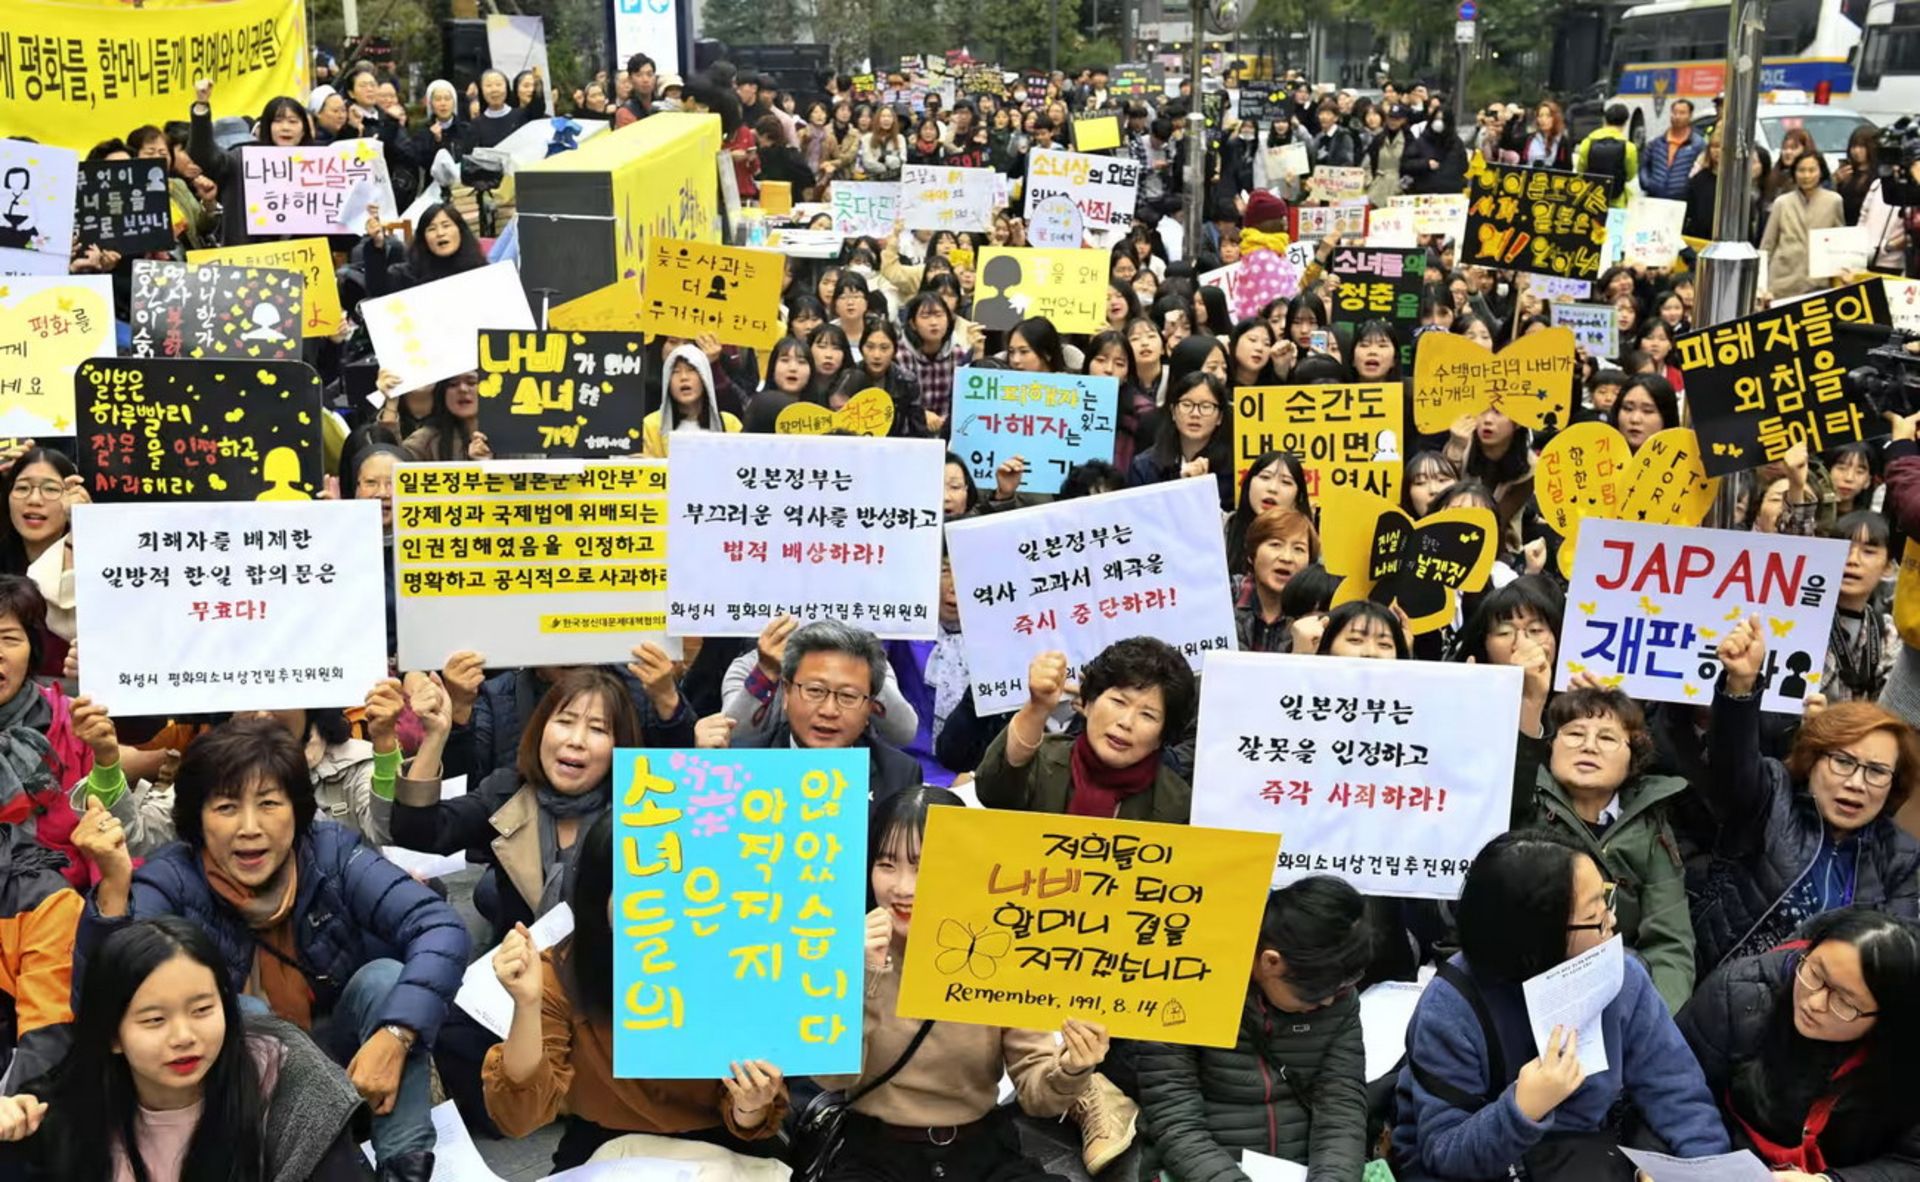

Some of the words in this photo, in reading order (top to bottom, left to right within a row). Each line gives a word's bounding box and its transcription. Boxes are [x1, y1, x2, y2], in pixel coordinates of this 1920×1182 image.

[18, 34, 97, 111] 평화를,
[97, 35, 186, 99] 할머니들께
[191, 29, 234, 87] 명예와
[236, 19, 277, 76] 인권을
[245, 157, 293, 184] 나비
[299, 157, 371, 189] 진실을
[1033, 154, 1104, 186] 소녀상의
[1106, 163, 1138, 188] 외침
[75, 188, 146, 215] 녀들을
[657, 245, 691, 270] 늦은
[696, 254, 756, 279] 사과는
[1078, 265, 1099, 285] 왜
[1333, 249, 1425, 277] 소녀들의
[681, 278, 702, 297] 더
[1338, 282, 1420, 319] 청춘을
[27, 307, 94, 340] 평화를
[194, 266, 221, 348] 아니한가
[733, 313, 768, 332] 한다
[1676, 284, 1875, 372] 피해자들의
[480, 332, 597, 375] 나비가
[1434, 357, 1522, 384] 수백마리의
[1526, 354, 1574, 374] 나비가
[89, 367, 145, 402] 일본은
[964, 375, 999, 401] 왜
[1001, 381, 1099, 412] 피해자는
[1416, 384, 1476, 408] 수십개의
[1483, 377, 1535, 413] 꽃으로
[1733, 349, 1848, 414] 외침을
[89, 400, 193, 438] 하루빨리
[1239, 392, 1265, 423] 이
[1285, 387, 1387, 424] 순간도
[977, 412, 1083, 447] 가해자는
[1757, 402, 1865, 462] 들어라
[91, 433, 166, 471] 잘못을
[173, 435, 260, 467] 인정하고
[1242, 431, 1370, 464] 내일이면
[95, 473, 195, 495] 사과해라
[399, 470, 505, 494] 일본정부는
[737, 466, 853, 492] 일본정부는
[1568, 445, 1588, 490] 향한
[1595, 436, 1618, 506] 기다림
[1543, 452, 1568, 528] 진실을
[402, 504, 484, 528] 강제성과
[492, 504, 574, 526] 국제법에
[578, 502, 659, 524] 위배되는
[682, 503, 772, 526] 부끄러운
[784, 505, 849, 529] 역사를
[856, 507, 939, 530] 반성하고
[137, 530, 231, 552] 피해자를
[243, 529, 313, 550] 배제한
[402, 533, 562, 560] 인권침해였음을
[575, 535, 655, 557] 인정하고
[723, 540, 769, 563] 법적
[782, 541, 885, 565] 배상하라!
[1018, 523, 1134, 562] 일본정부는
[101, 565, 170, 588] 일방적
[244, 562, 338, 586] 합의문은
[403, 571, 486, 593] 명확하고
[493, 567, 596, 591] 공식적으로
[973, 580, 1017, 607] 역사
[1029, 565, 1092, 597] 교과서
[1102, 552, 1165, 582] 왜곡을
[1415, 553, 1467, 586] 날갯짓
[187, 599, 268, 622] 무효다!
[671, 601, 716, 618] 화성시
[726, 602, 928, 622] 평화의소녀상건립추진위원회
[1013, 608, 1058, 636] 즉시
[1581, 615, 1780, 690] 재판
[118, 671, 159, 688] 화성시
[168, 667, 345, 688] 평화의소녀상건립추진위원회
[978, 678, 1023, 698] 화성시
[1279, 694, 1415, 725] 일본정부는
[1237, 735, 1317, 765] 잘못을
[1331, 739, 1430, 768] 인정하고
[1259, 780, 1313, 806] 즉각
[1327, 782, 1447, 812] 사죄하라!
[737, 787, 788, 884] 아직
[1041, 831, 1174, 872] 저희들이
[1277, 851, 1476, 878] 화의소녀상건립추진위원
[620, 754, 686, 1030] 소녀들의
[987, 863, 1120, 899] 나비가
[1135, 876, 1205, 905] 되어
[789, 768, 850, 1046] 않았습니다
[728, 891, 785, 981] 지지
[992, 901, 1110, 940] 할머니
[1126, 910, 1191, 947] 곁을
[1014, 946, 1213, 984] 지키겠습니다
[1136, 999, 1159, 1018] 14
